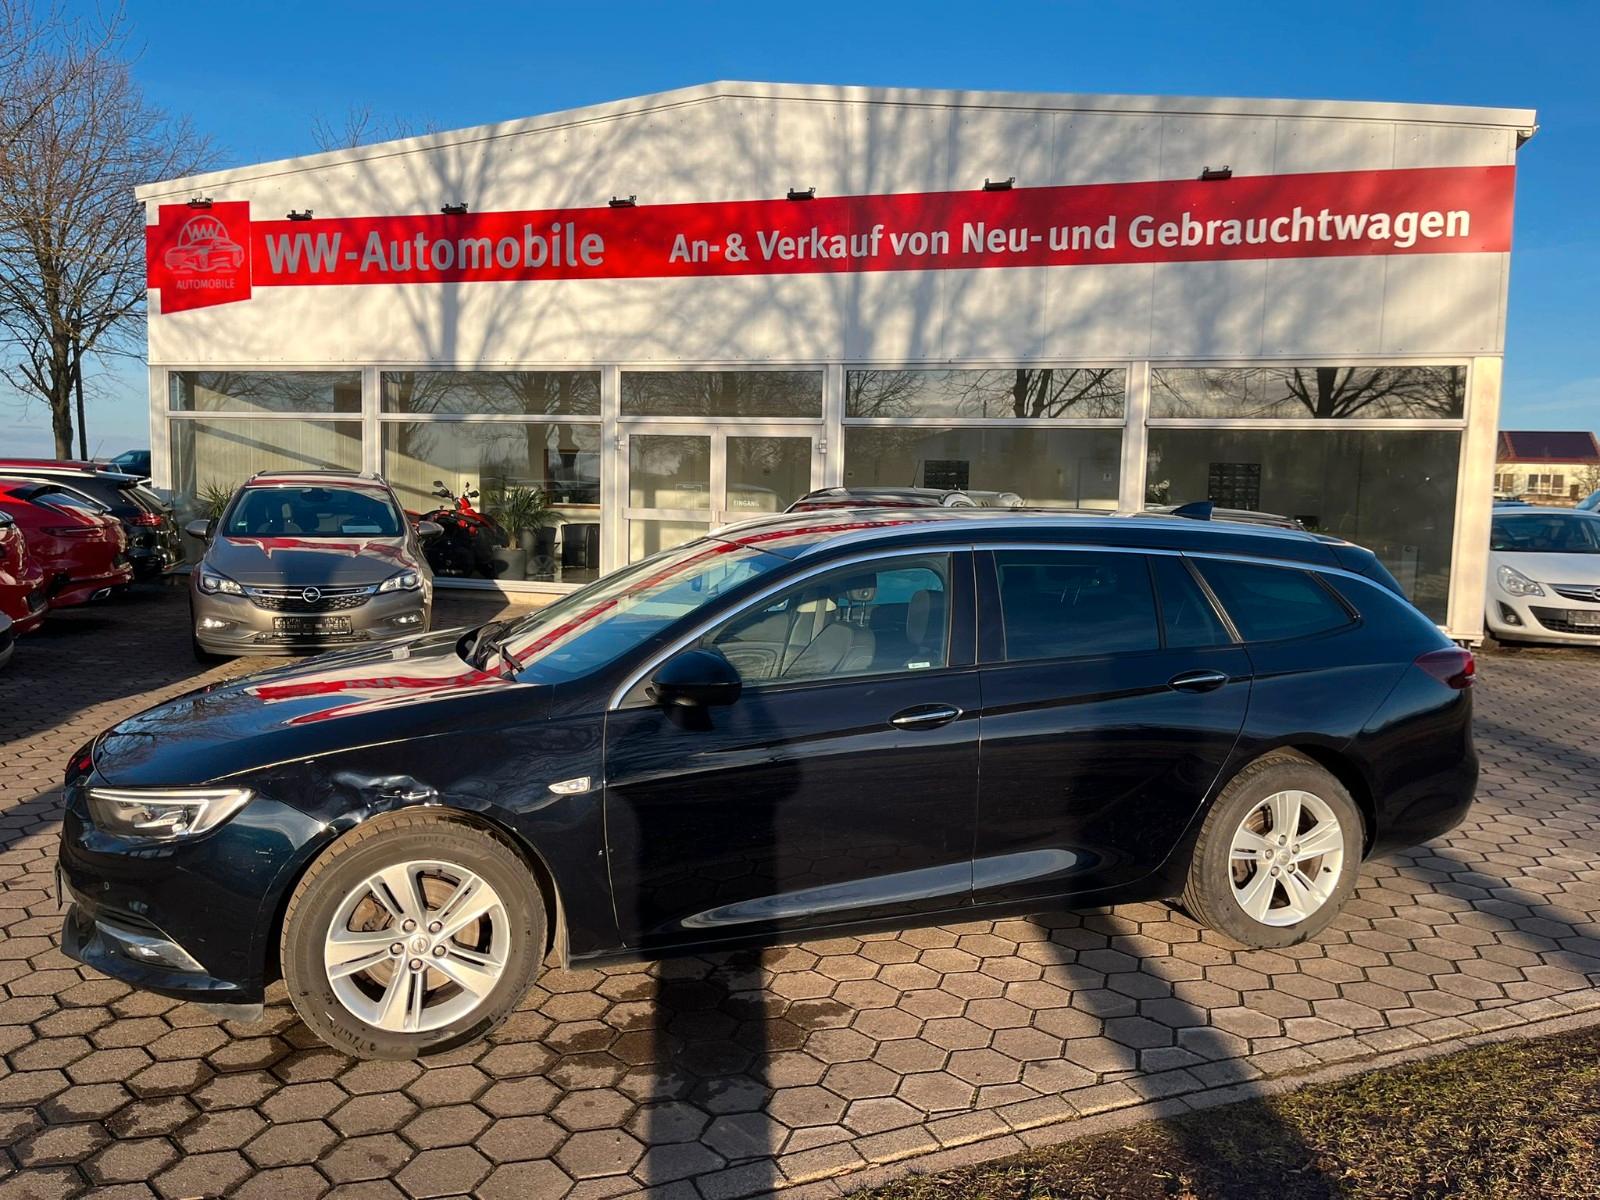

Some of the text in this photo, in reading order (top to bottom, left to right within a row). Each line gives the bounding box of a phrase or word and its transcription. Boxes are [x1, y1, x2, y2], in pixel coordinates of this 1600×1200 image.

[264, 222, 606, 274] WW-Automobile
[724, 233, 748, 262] &
[756, 224, 884, 260] Verkauf
[889, 230, 949, 256] von
[961, 221, 1042, 254] Neu-
[1049, 215, 1117, 250] und
[1128, 206, 1471, 248] Gebrauchtwagen
[176, 278, 236, 290] AUTOMOBILE
